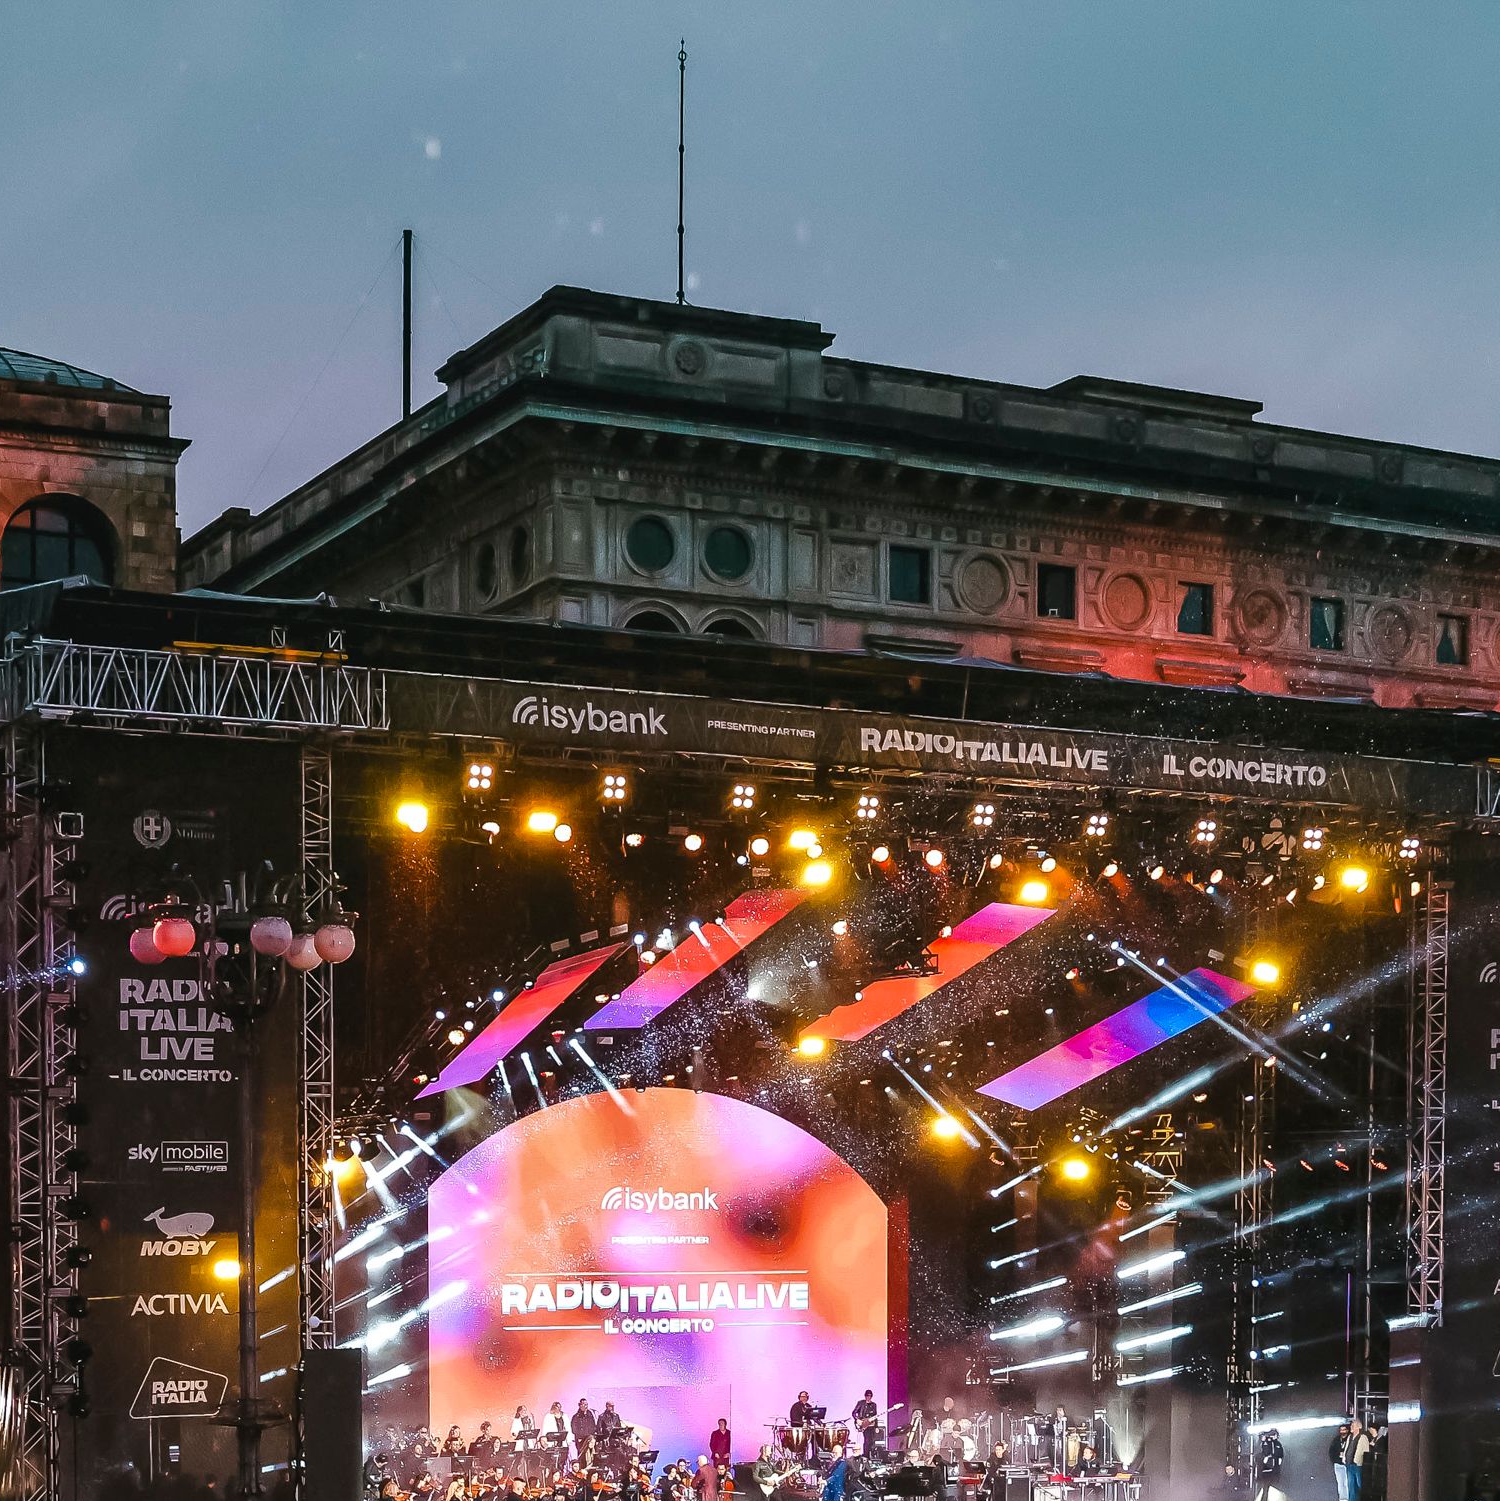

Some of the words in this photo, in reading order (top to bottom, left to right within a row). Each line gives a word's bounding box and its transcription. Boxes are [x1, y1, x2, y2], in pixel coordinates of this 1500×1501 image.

[542, 697, 668, 736] isybank
[707, 720, 768, 735] PRESENTING
[769, 726, 816, 739] PARTNER
[1163, 753, 1184, 776] IL
[1189, 755, 1327, 787] CONCERTO
[119, 1007, 234, 1033] ITALIA
[140, 1037, 214, 1061] LIVE
[122, 1069, 137, 1081] IL
[139, 1068, 232, 1082] CONCERTO
[1491, 1099, 1500, 1110] IL
[128, 1143, 159, 1163] sky
[166, 1144, 224, 1159] mobile
[184, 1165, 228, 1173] FASTWEB
[624, 1186, 719, 1214] isybank
[140, 1240, 216, 1256] MOBY
[668, 1236, 710, 1245] PARTNER
[131, 1293, 229, 1316] ACTIVIA
[604, 1319, 619, 1335] IL
[621, 1318, 715, 1335] CONCERTO
[152, 1380, 208, 1394] RADIO
[151, 1391, 208, 1405] ITALIA
